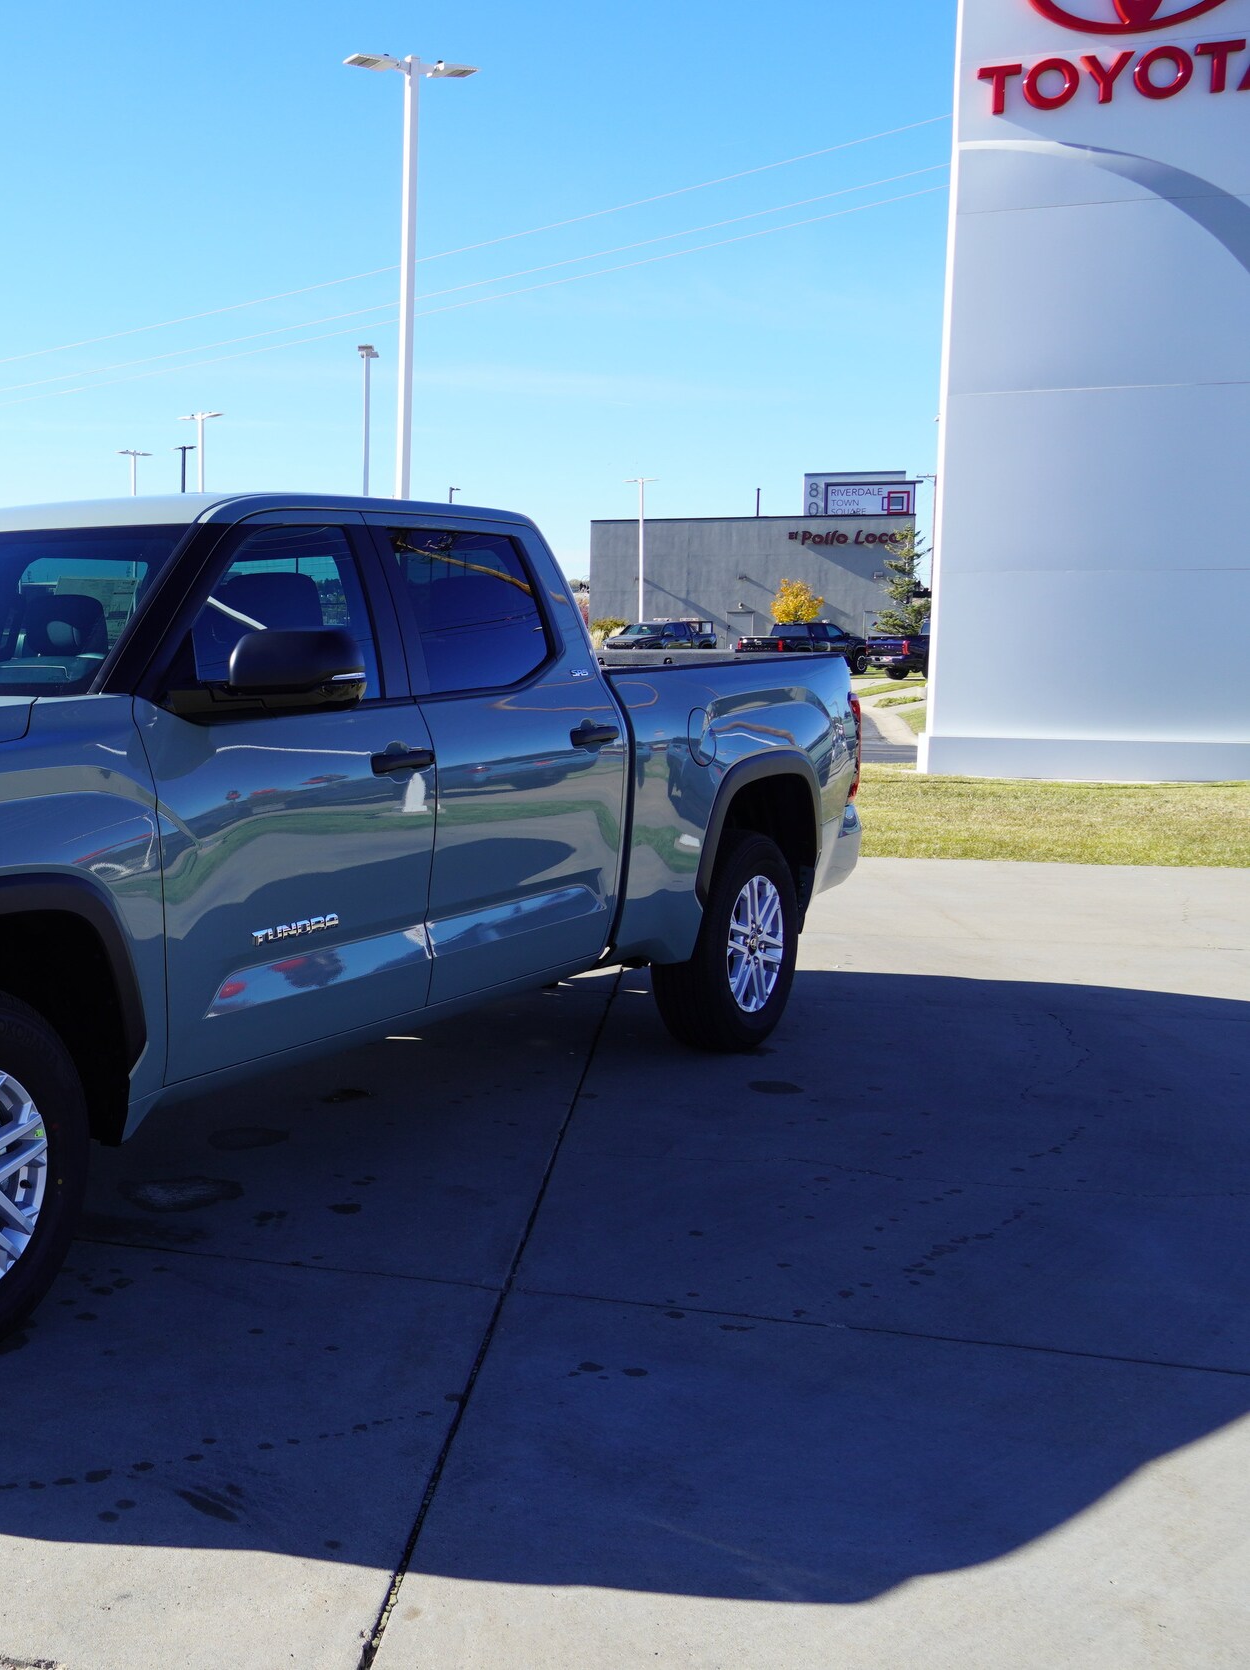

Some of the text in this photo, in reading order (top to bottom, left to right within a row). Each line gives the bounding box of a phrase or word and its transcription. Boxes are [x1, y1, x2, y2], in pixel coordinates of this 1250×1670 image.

[977, 38, 1250, 115] TOYOT
[830, 487, 884, 497] RIVERDALE
[830, 499, 860, 507] TOWN
[788, 529, 901, 545] El Pollo Loco
[251, 913, 339, 946] TUNDRA
